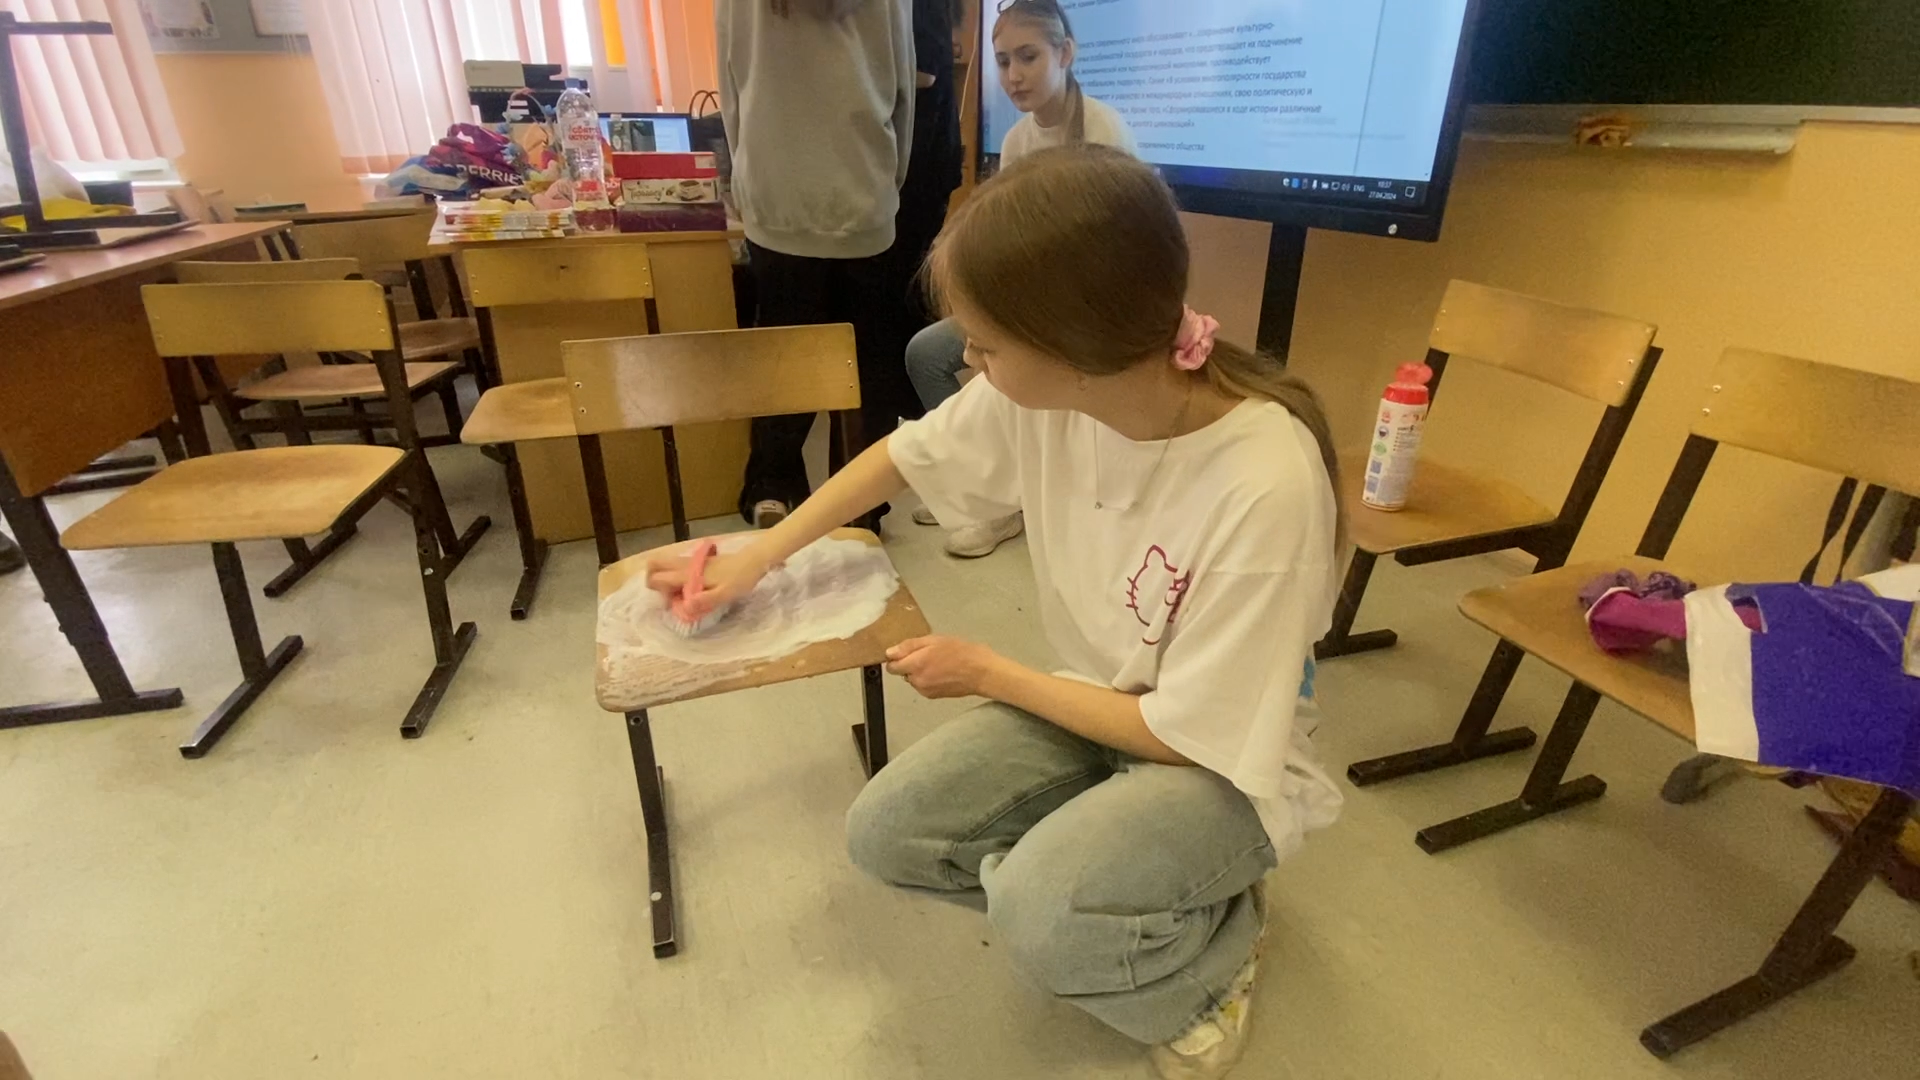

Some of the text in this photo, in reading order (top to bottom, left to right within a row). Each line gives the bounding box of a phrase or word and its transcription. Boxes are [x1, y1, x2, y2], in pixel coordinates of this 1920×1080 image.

[1236, 21, 1275, 34] культурно-
[1256, 36, 1303, 49] подчинение
[1252, 87, 1306, 98] политическую
